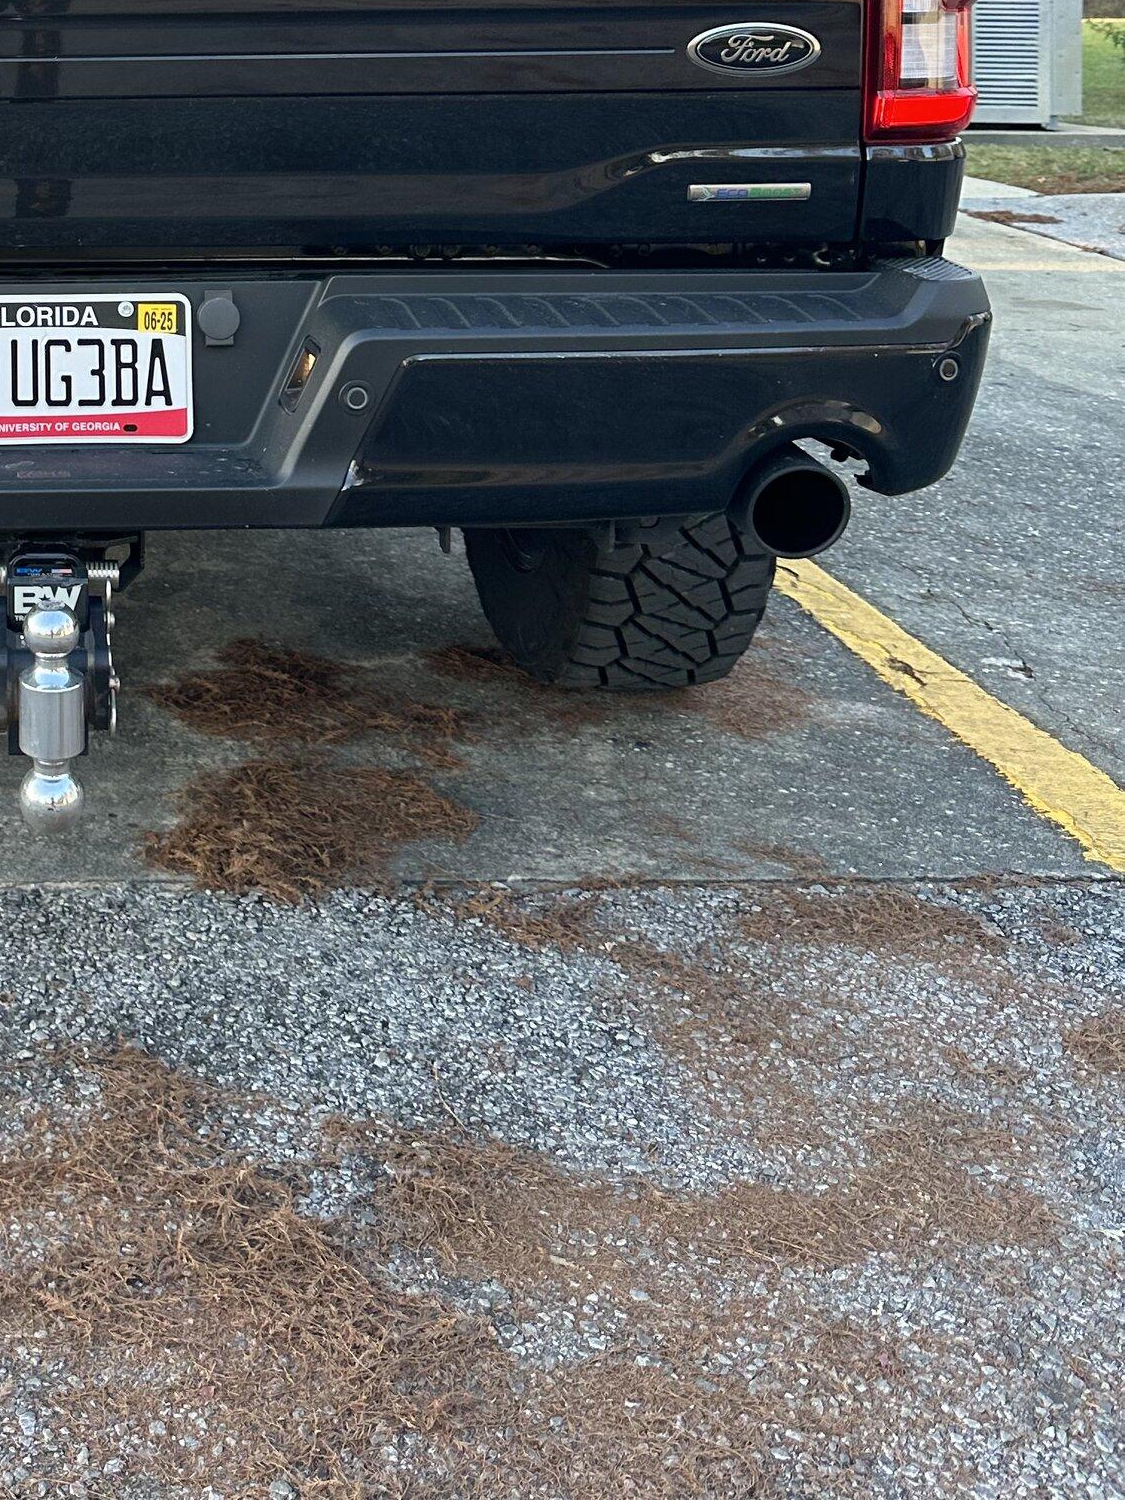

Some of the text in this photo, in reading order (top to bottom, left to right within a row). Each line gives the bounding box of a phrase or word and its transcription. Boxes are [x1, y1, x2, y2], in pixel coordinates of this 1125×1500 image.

[720, 34, 805, 63] Ford
[144, 311, 173, 331] 06-25
[11, 338, 173, 407] UG3BA
[55, 422, 70, 431] OF
[72, 421, 121, 431] GEORGIA
